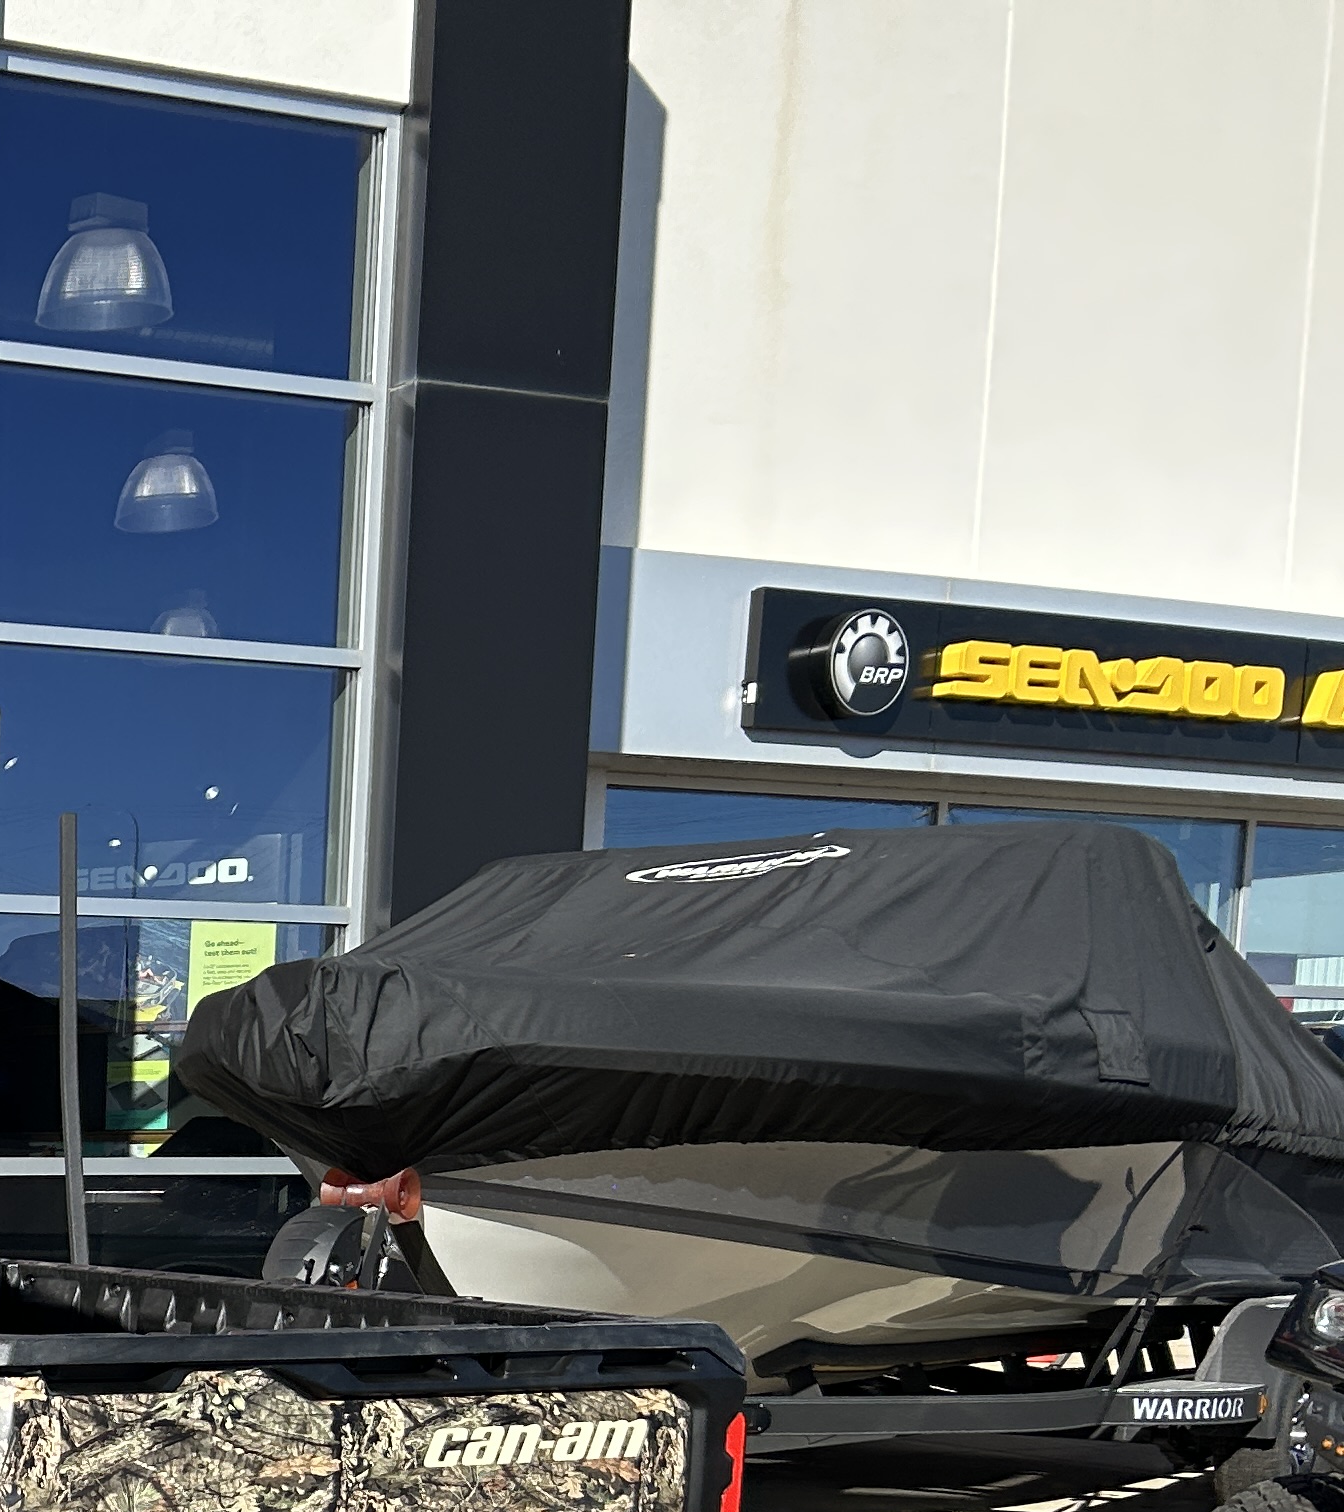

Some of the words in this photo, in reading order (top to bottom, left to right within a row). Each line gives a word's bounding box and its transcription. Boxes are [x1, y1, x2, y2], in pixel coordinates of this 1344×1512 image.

[858, 665, 904, 685] BRP
[1132, 1397, 1244, 1420] WARRIOR
[423, 1418, 651, 1468] can-am
